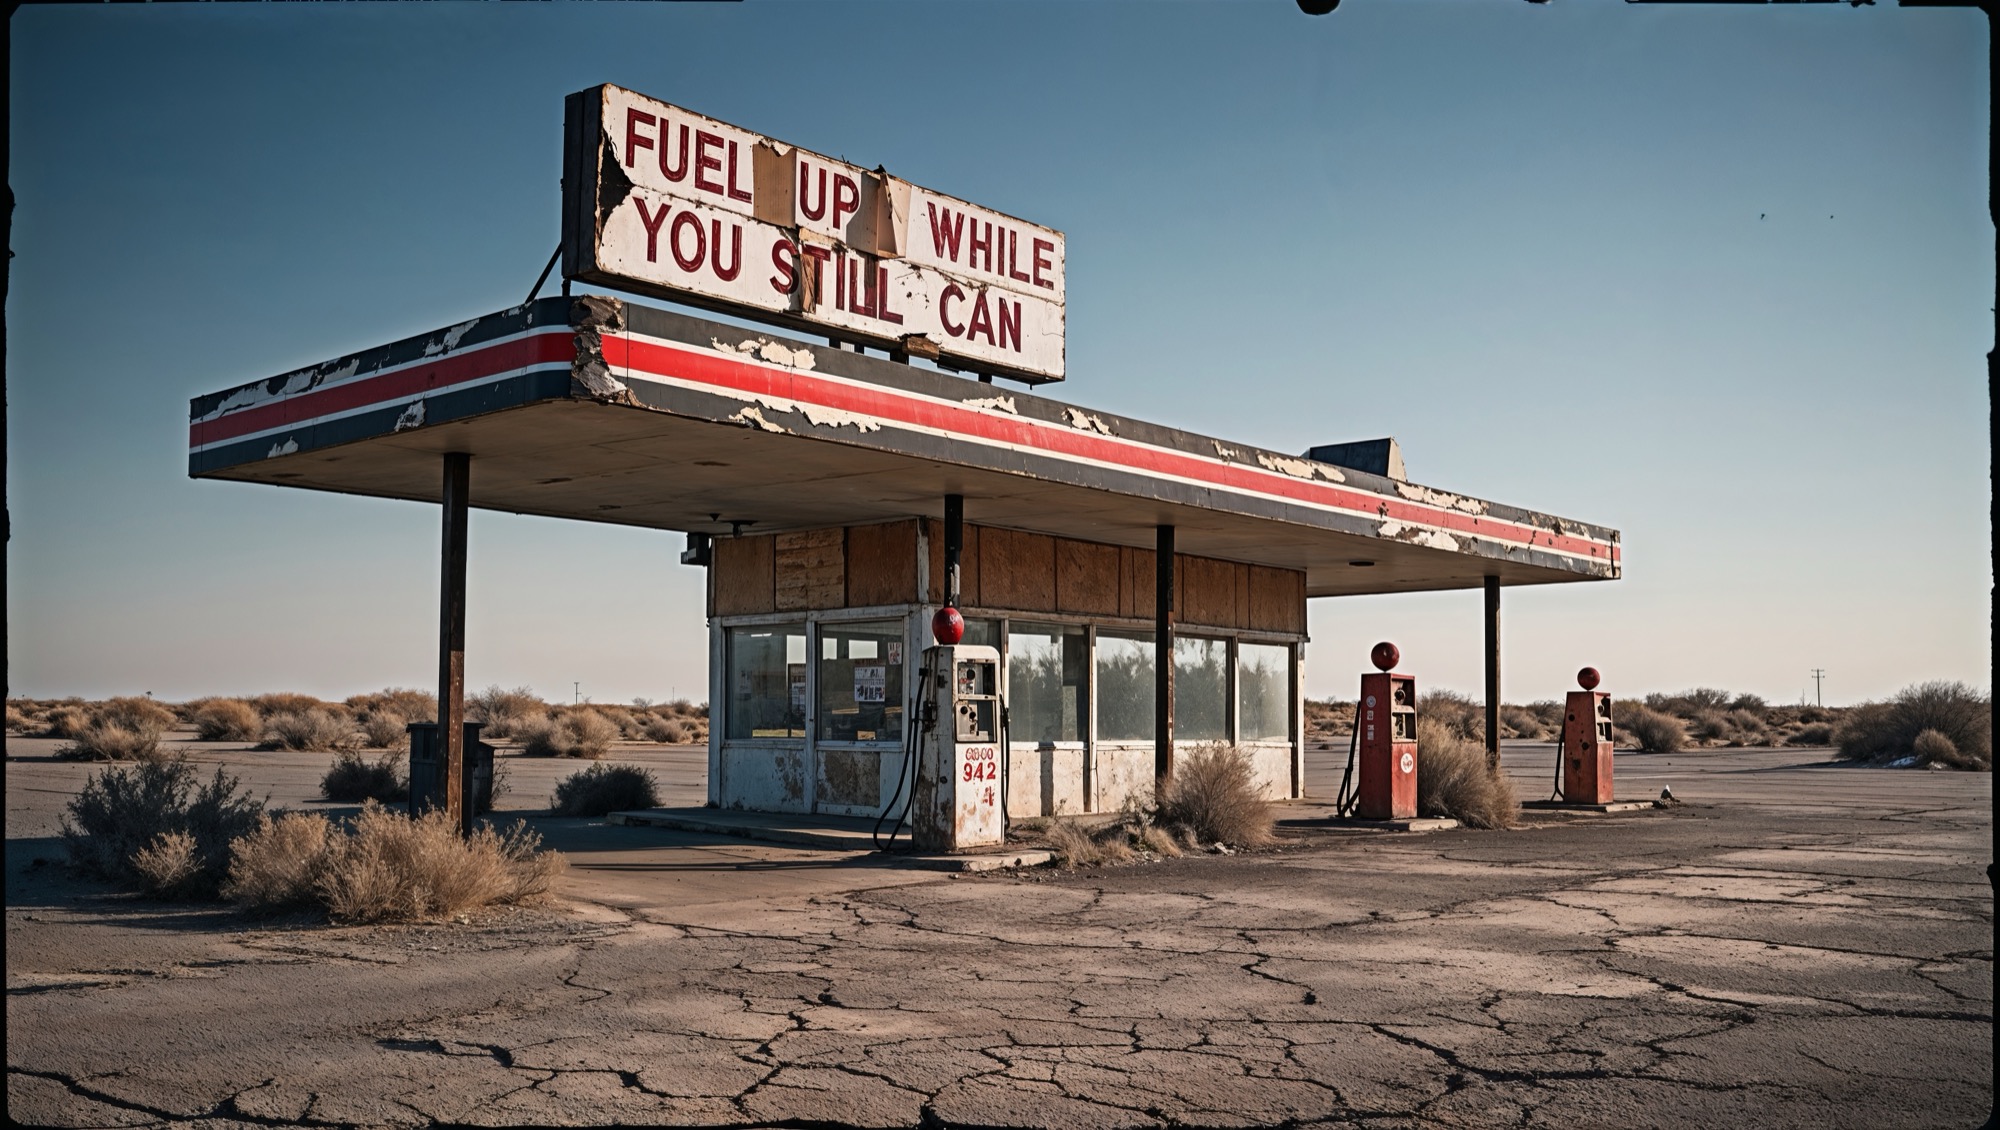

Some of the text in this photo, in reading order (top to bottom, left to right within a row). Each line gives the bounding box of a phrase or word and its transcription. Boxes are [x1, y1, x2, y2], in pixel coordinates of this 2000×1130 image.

[625, 106, 1055, 291] FUEL UP WHILE
[632, 196, 1022, 354] YOU STILL CAN
[963, 761, 996, 782] 942
